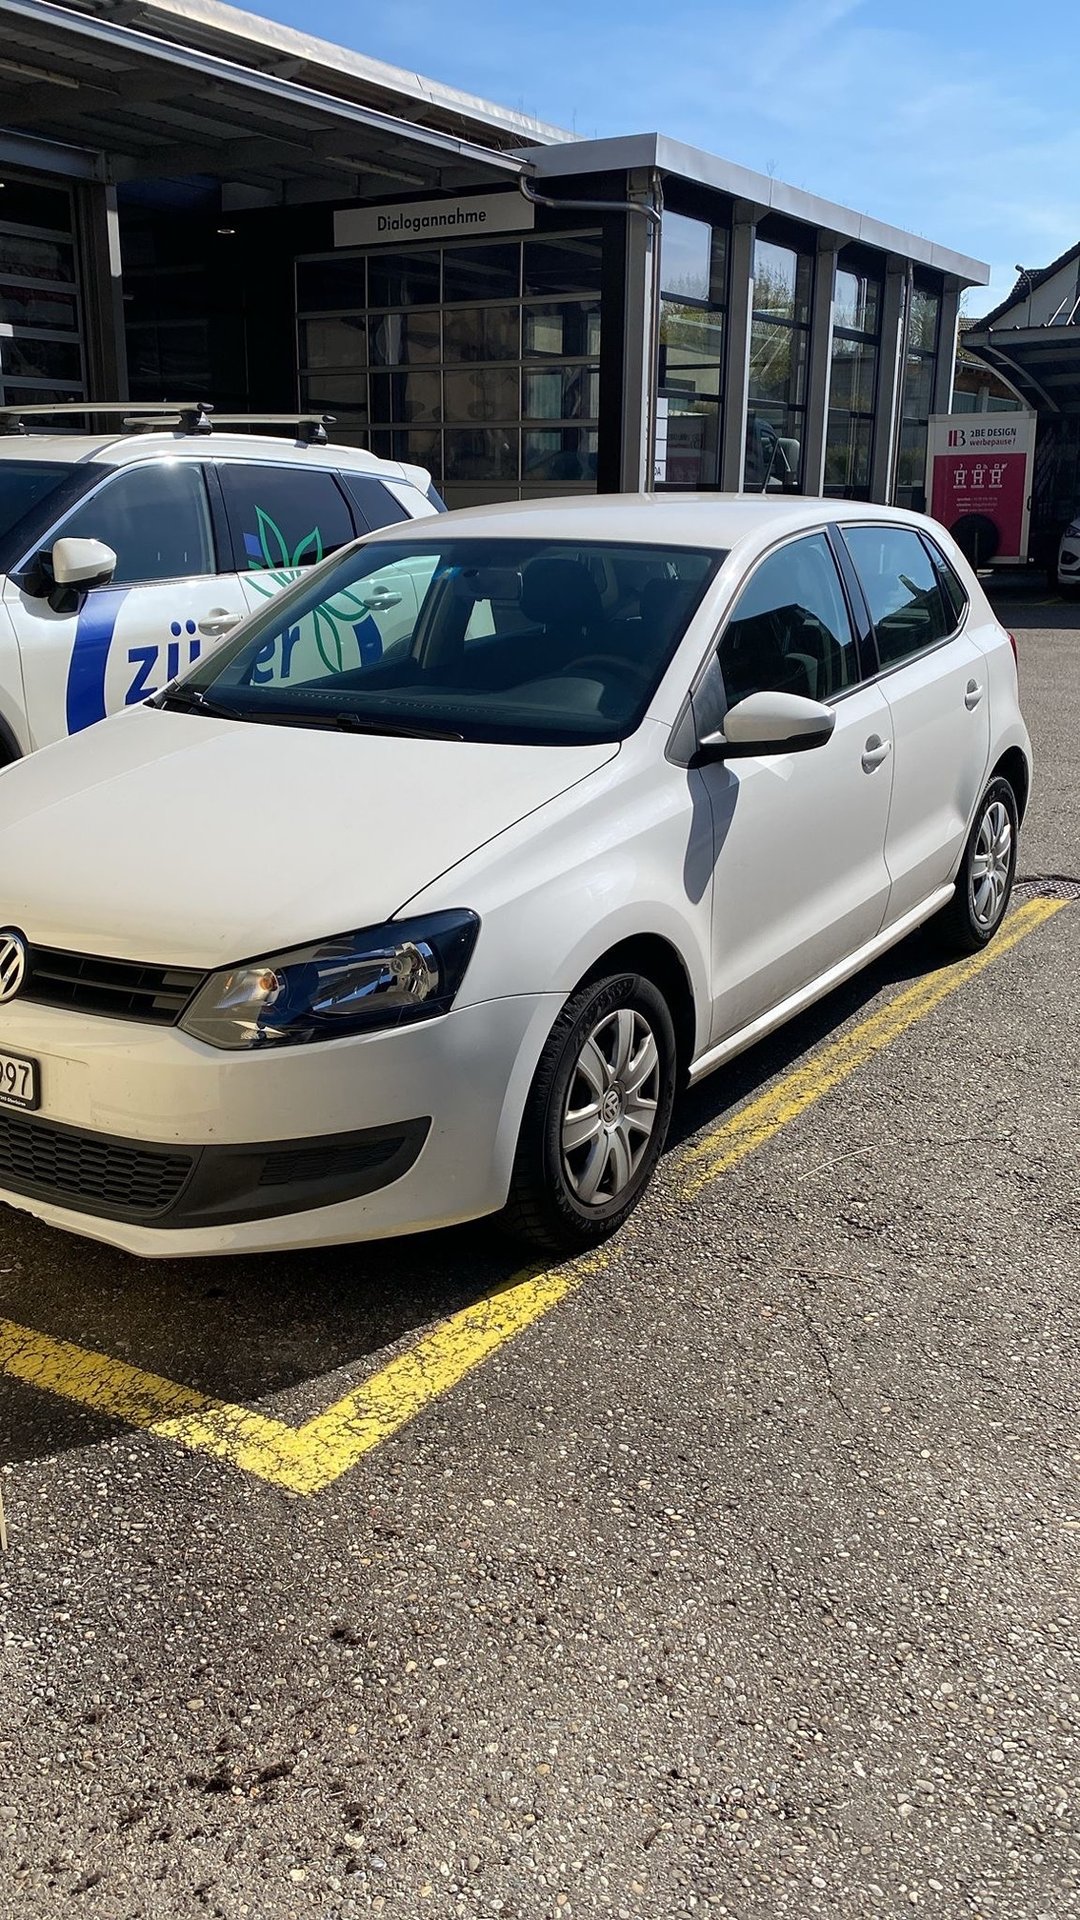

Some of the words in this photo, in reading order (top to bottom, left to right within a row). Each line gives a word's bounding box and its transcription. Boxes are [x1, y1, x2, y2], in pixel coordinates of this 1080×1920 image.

[377, 207, 487, 232] Dialogannahme
[970, 429, 986, 437] 2BE
[987, 427, 1016, 437] DESIGN
